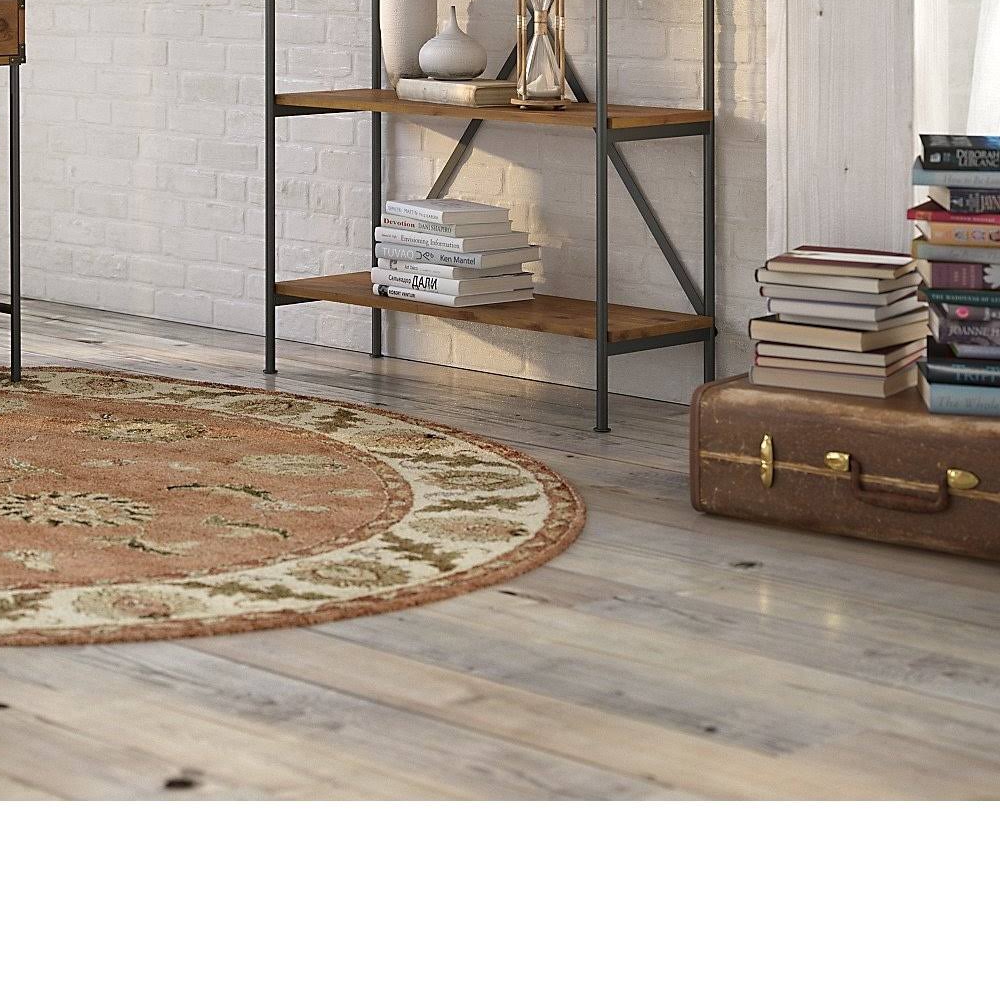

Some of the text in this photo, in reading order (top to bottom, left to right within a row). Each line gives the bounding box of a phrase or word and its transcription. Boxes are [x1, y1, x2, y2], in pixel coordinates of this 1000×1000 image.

[384, 217, 415, 228] Devotion
[440, 254, 476, 265] Ken Mantel
[412, 275, 438, 290] ДАЛИ
